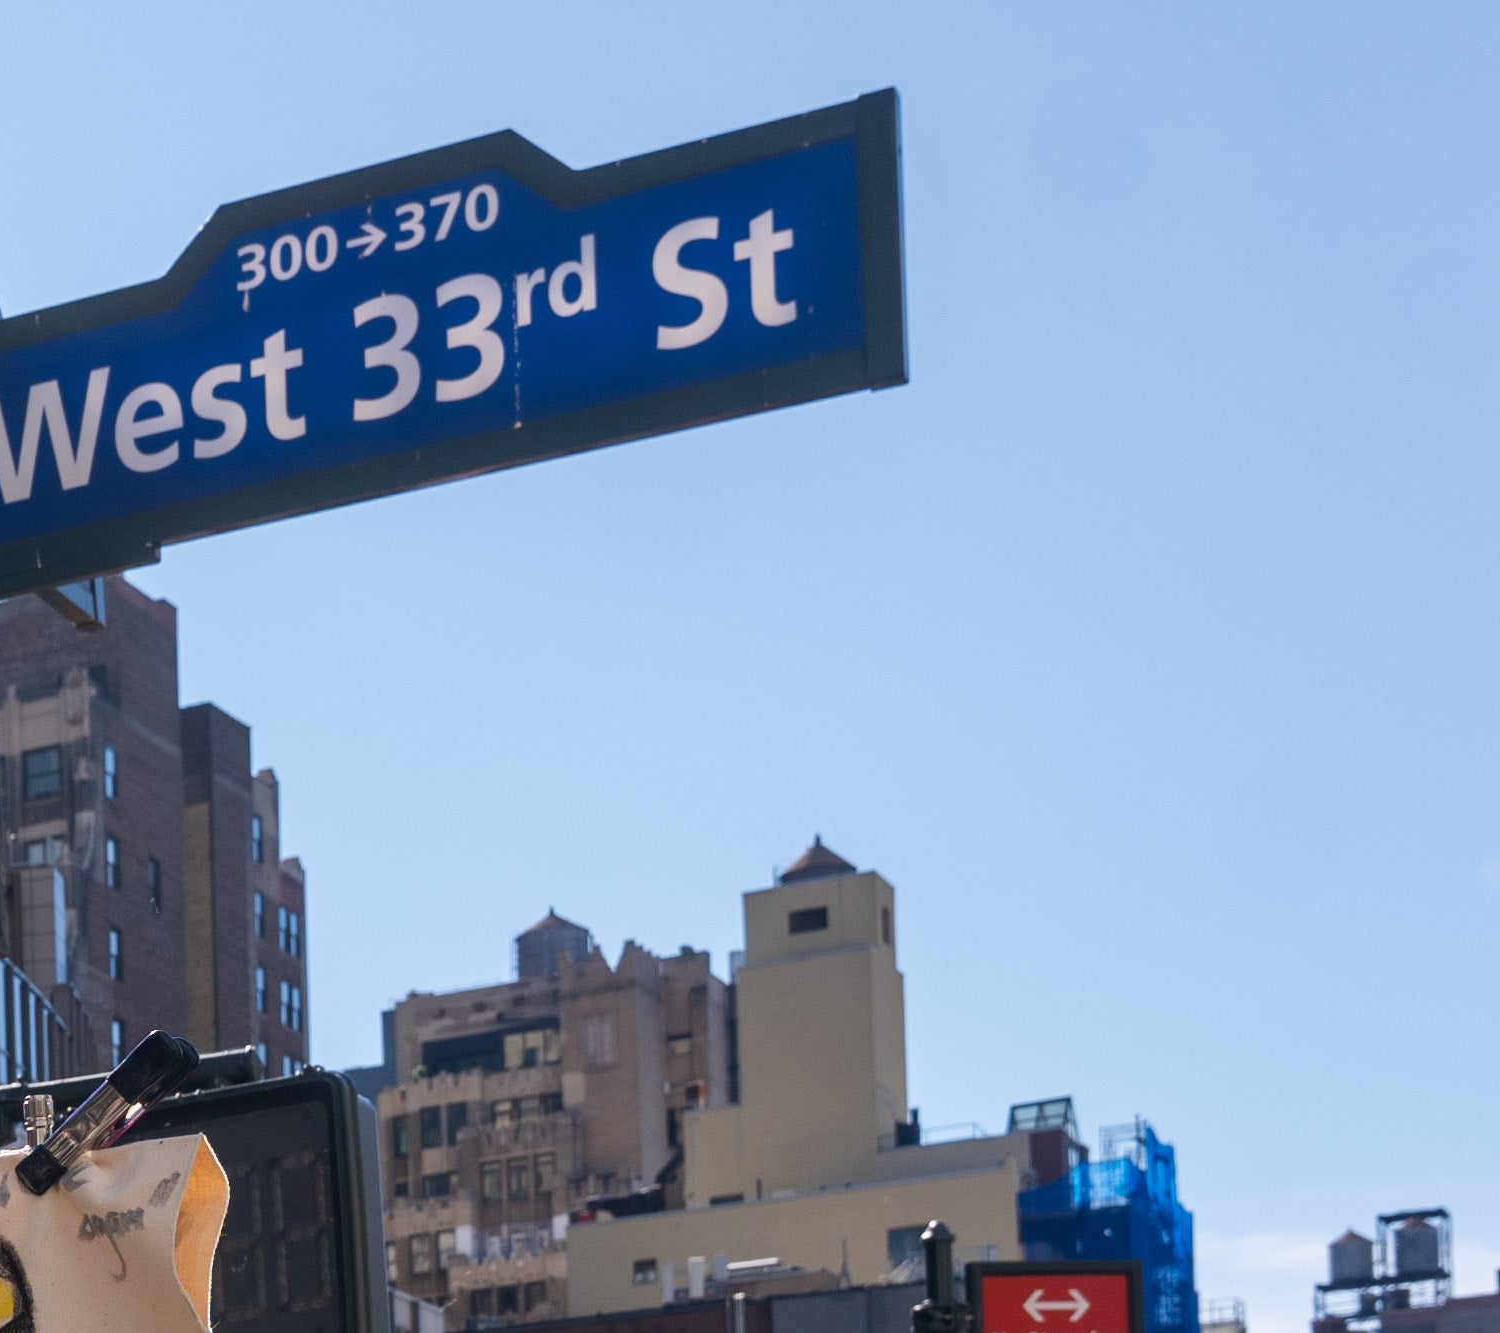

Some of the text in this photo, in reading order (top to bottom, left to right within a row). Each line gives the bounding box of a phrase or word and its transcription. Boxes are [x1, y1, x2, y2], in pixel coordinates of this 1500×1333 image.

[235, 182, 499, 294] 300 370
[350, 235, 598, 422] 33rd
[651, 210, 798, 352] St
